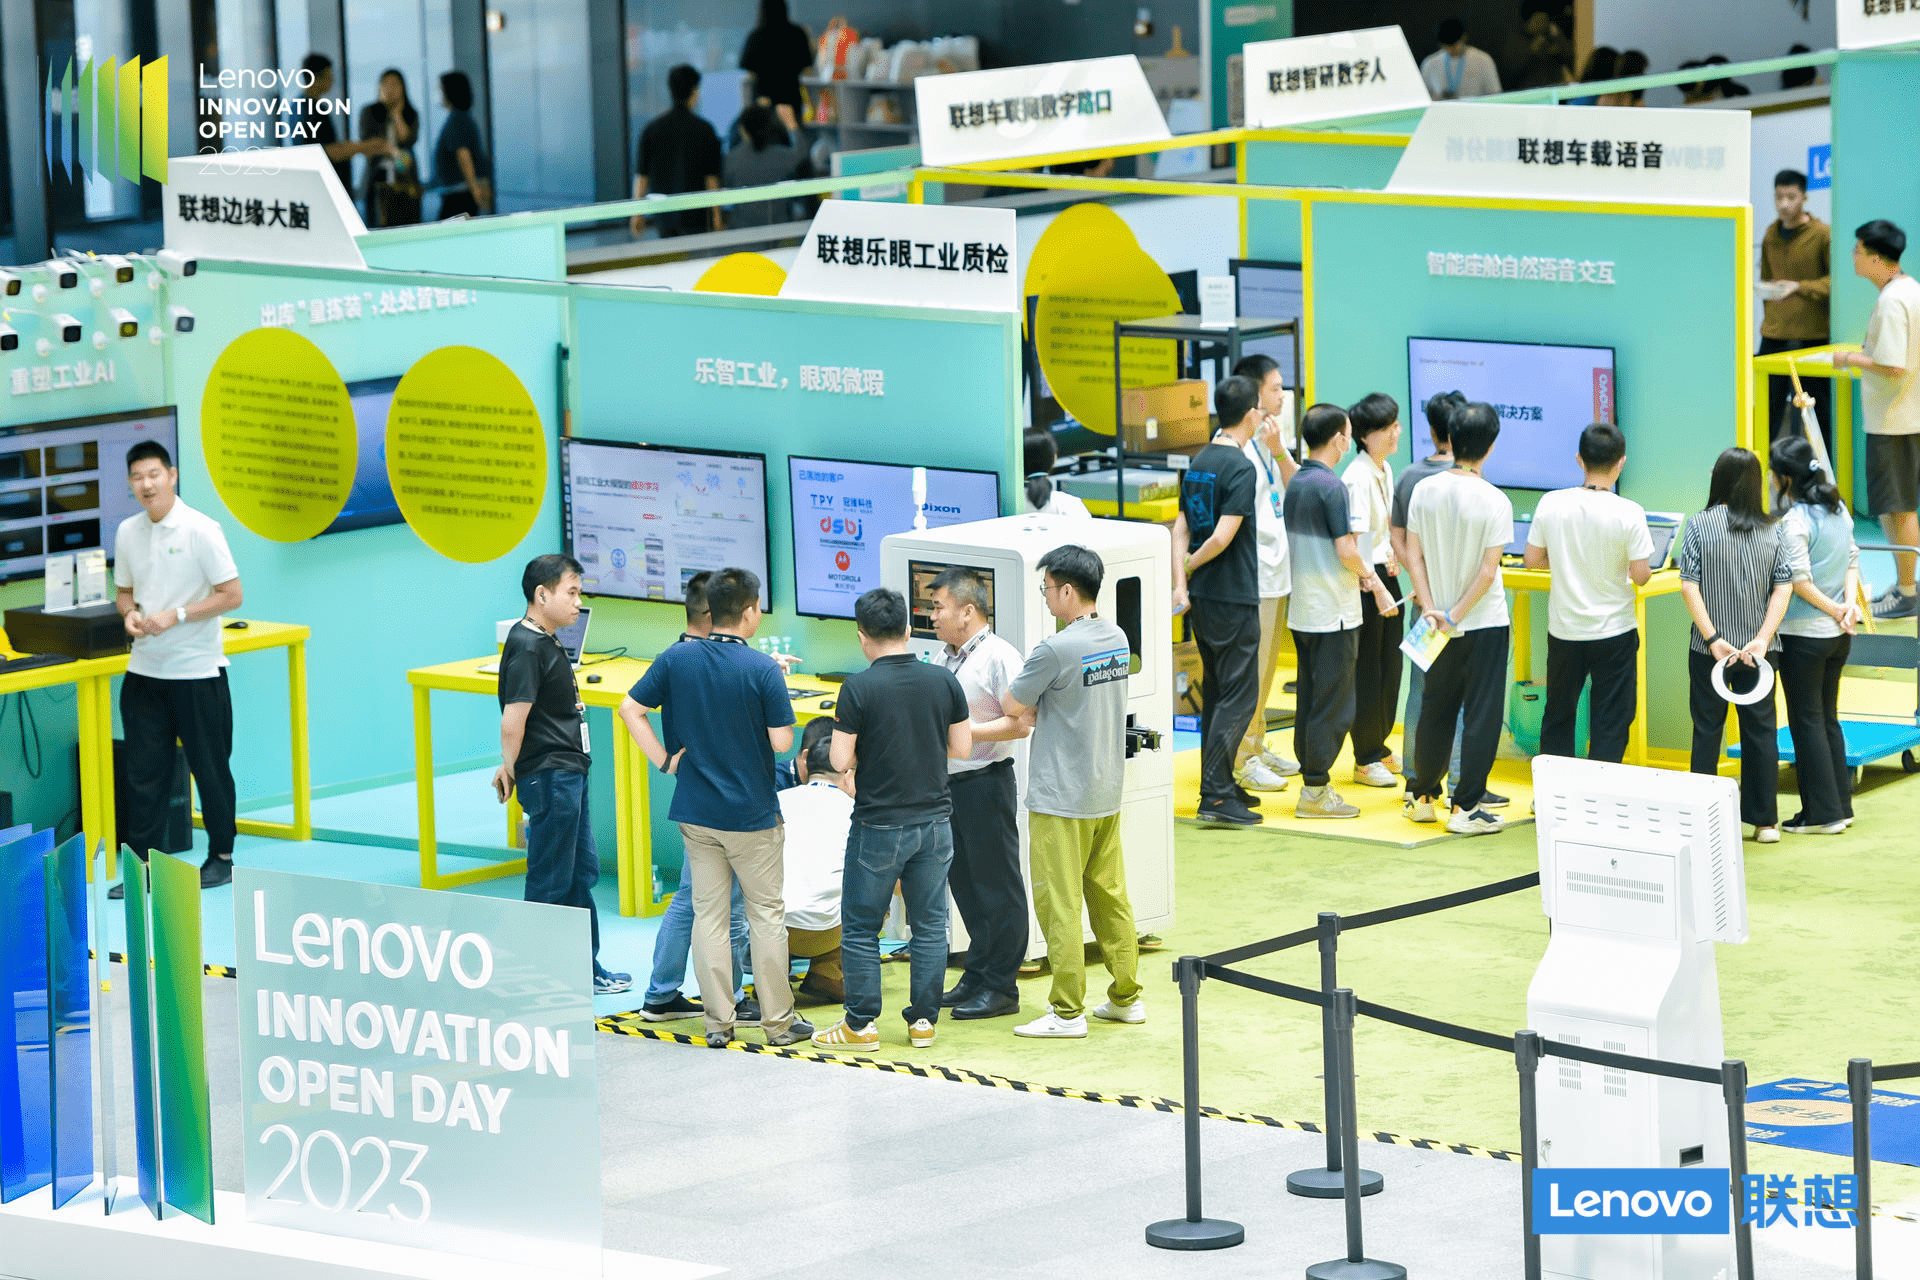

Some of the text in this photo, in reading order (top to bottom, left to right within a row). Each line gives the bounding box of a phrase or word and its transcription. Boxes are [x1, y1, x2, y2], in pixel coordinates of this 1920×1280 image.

[1267, 56, 1386, 93] 联想智研数字人
[948, 89, 1111, 128] 联想车联网数字路口
[1516, 137, 1664, 169] 联想车载语音
[178, 193, 310, 230] 联想边缘大脑
[817, 234, 1009, 274] 联想乐眼工业质检
[1427, 251, 1616, 285] 智能座舱自然语音交互
[810, 494, 834, 507] TPV
[820, 516, 862, 541] dsbj
[828, 573, 861, 583] MOTOROLA
[255, 890, 494, 989] Lenovo
[257, 989, 571, 1079] INNOVATION
[258, 1056, 512, 1134] OPEN DAY
[259, 1124, 431, 1225] 2023
